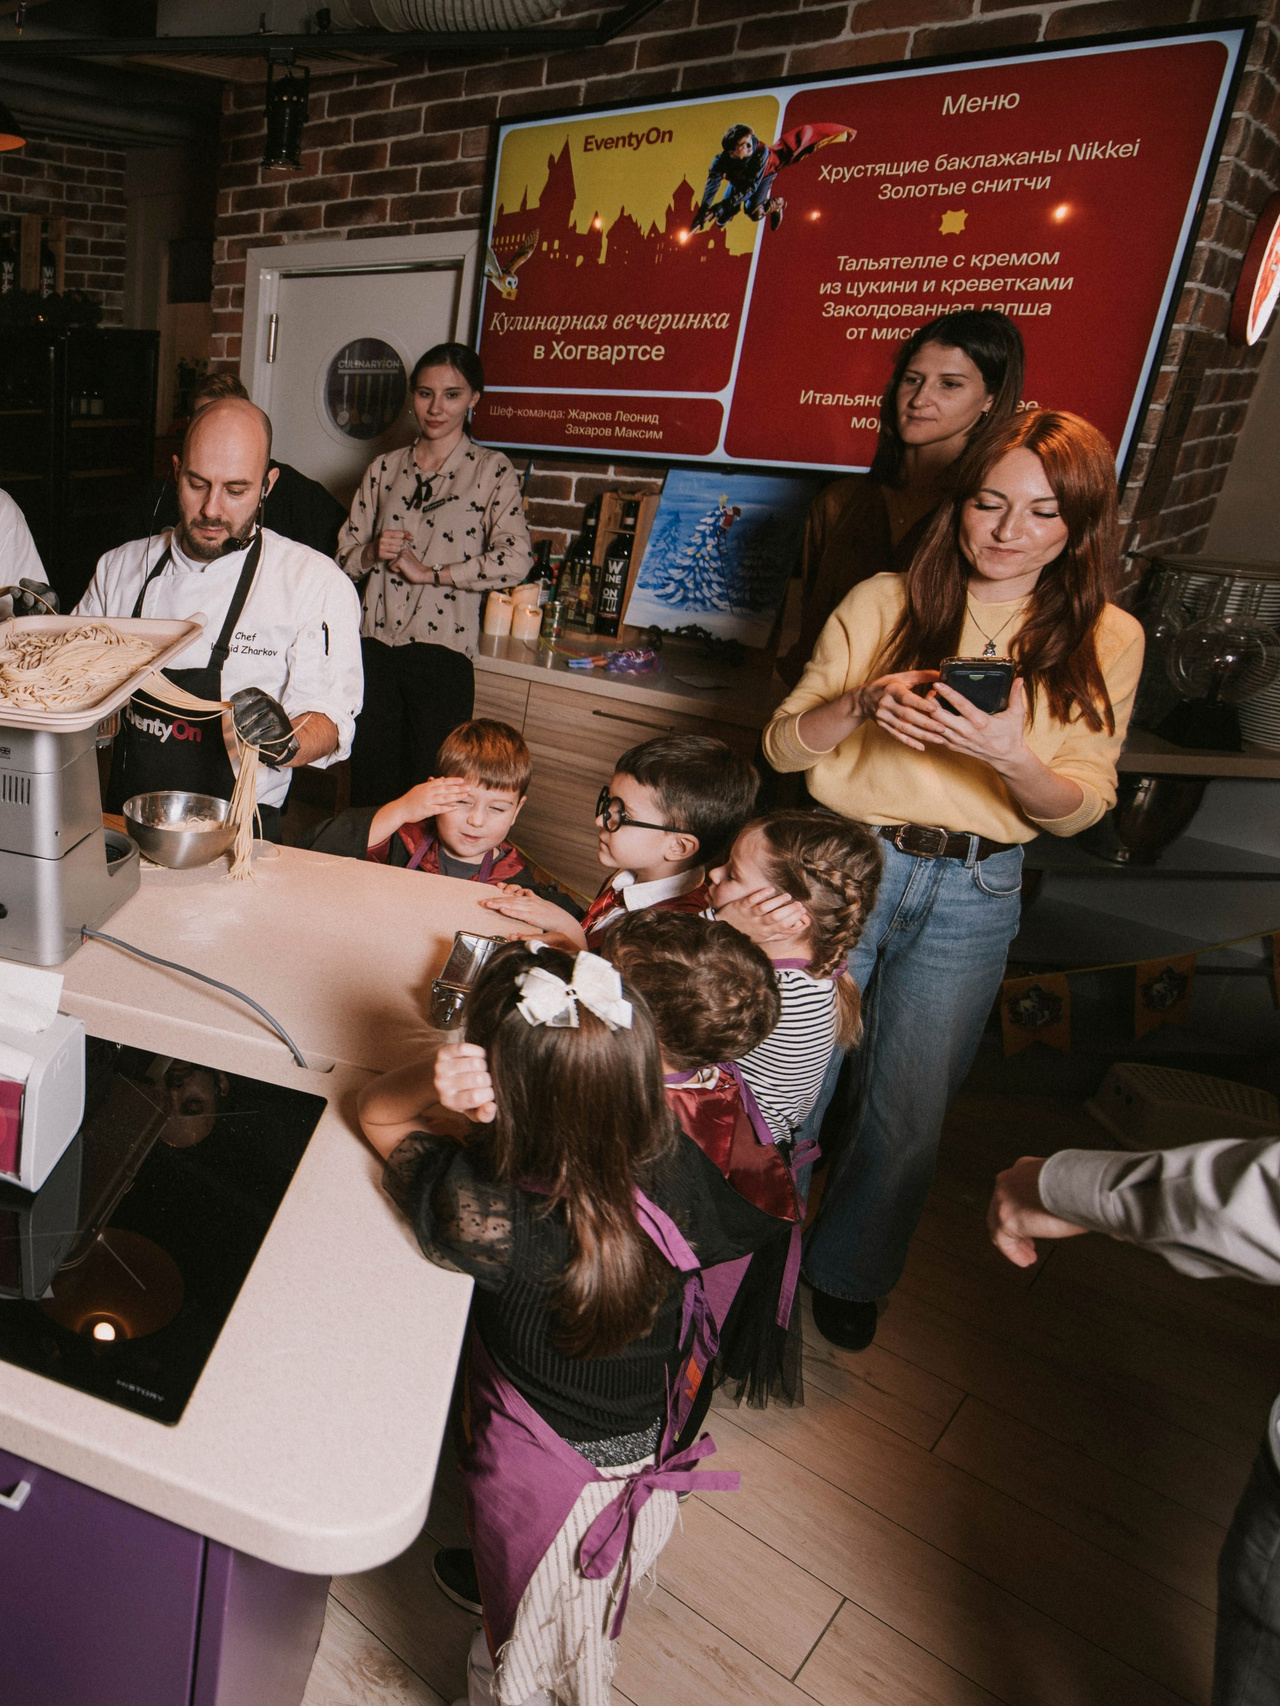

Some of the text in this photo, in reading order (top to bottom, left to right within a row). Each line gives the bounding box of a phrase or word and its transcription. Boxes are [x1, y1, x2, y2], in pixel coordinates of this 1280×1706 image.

[942, 91, 1021, 116] Меню
[583, 126, 674, 152] EventyOn
[818, 139, 1141, 182] Хрустящие баклажаны Nikkei
[878, 174, 1052, 200] Золотые снитчи
[836, 250, 1060, 273] Тальятелле с кремом
[819, 275, 1074, 298] из цукини и креветками
[488, 309, 730, 335] Кулинарная вечеринка
[846, 327, 868, 340] от
[533, 341, 665, 365] в Хогвартсе
[489, 404, 660, 425] Шеф-команда: Жарков Леонид
[564, 423, 663, 440] Захаров Максим
[602, 587, 618, 598] ON
[235, 631, 257, 642] Chef
[241, 645, 278, 657] Zharkov
